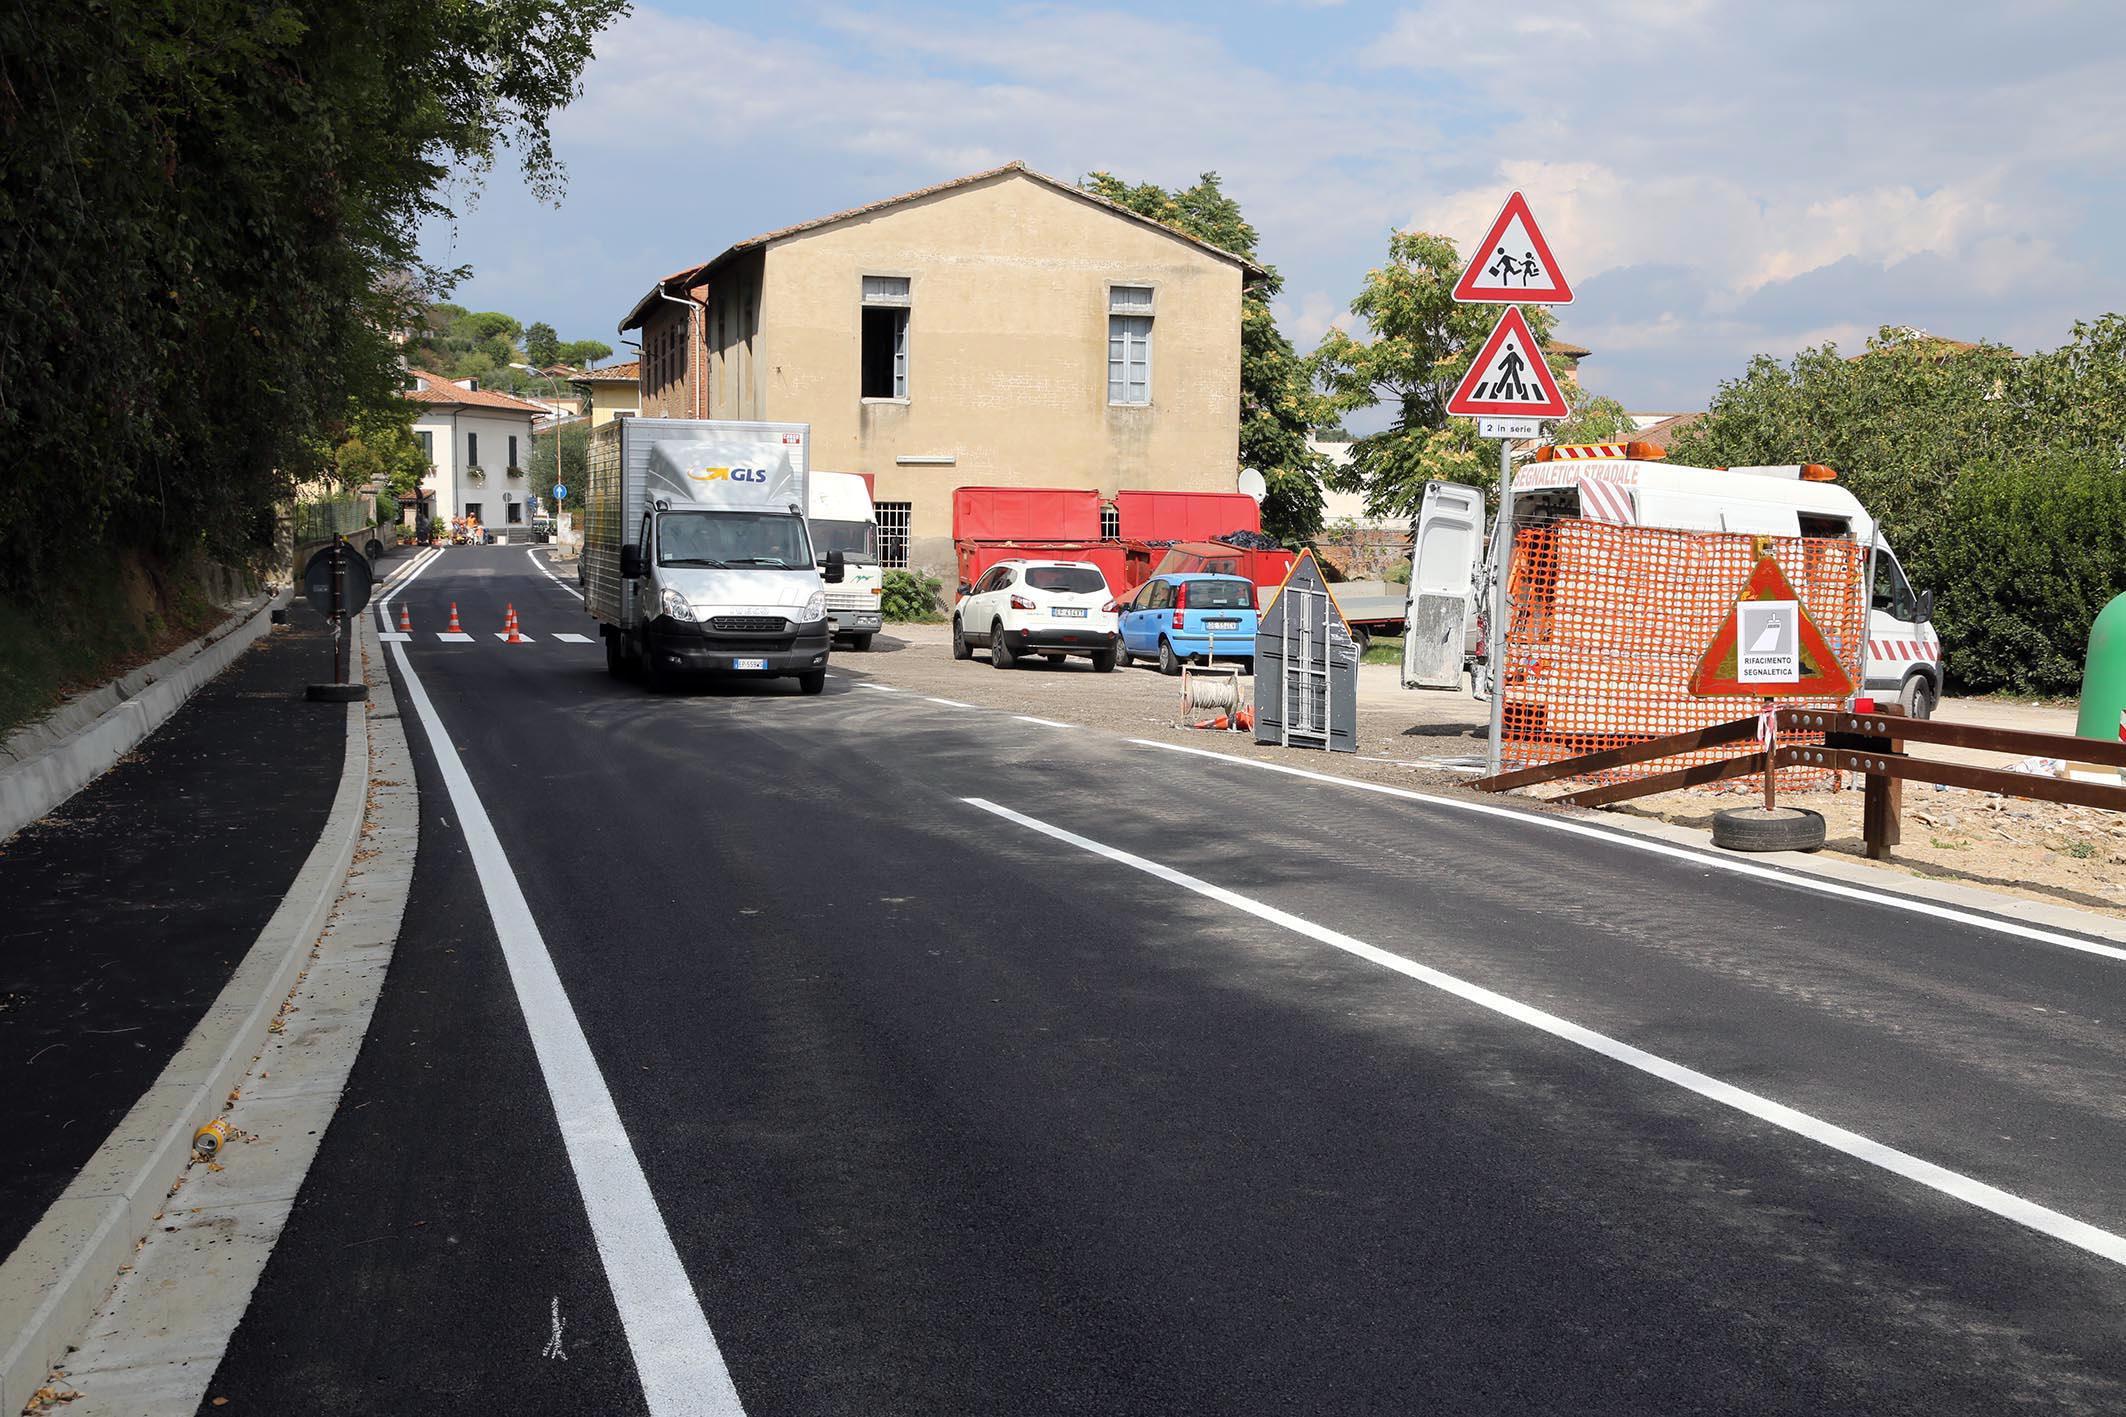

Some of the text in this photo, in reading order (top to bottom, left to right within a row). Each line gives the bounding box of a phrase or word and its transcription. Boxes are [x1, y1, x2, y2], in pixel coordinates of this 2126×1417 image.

[1487, 424, 1532, 433] 2 in serie
[730, 468, 767, 483] GLS
[1513, 463, 1640, 488] SEGNALETICA STRADALE
[1744, 657, 1792, 665] RIFACIMENTO
[1743, 668, 1793, 676] SEGNALETICA
